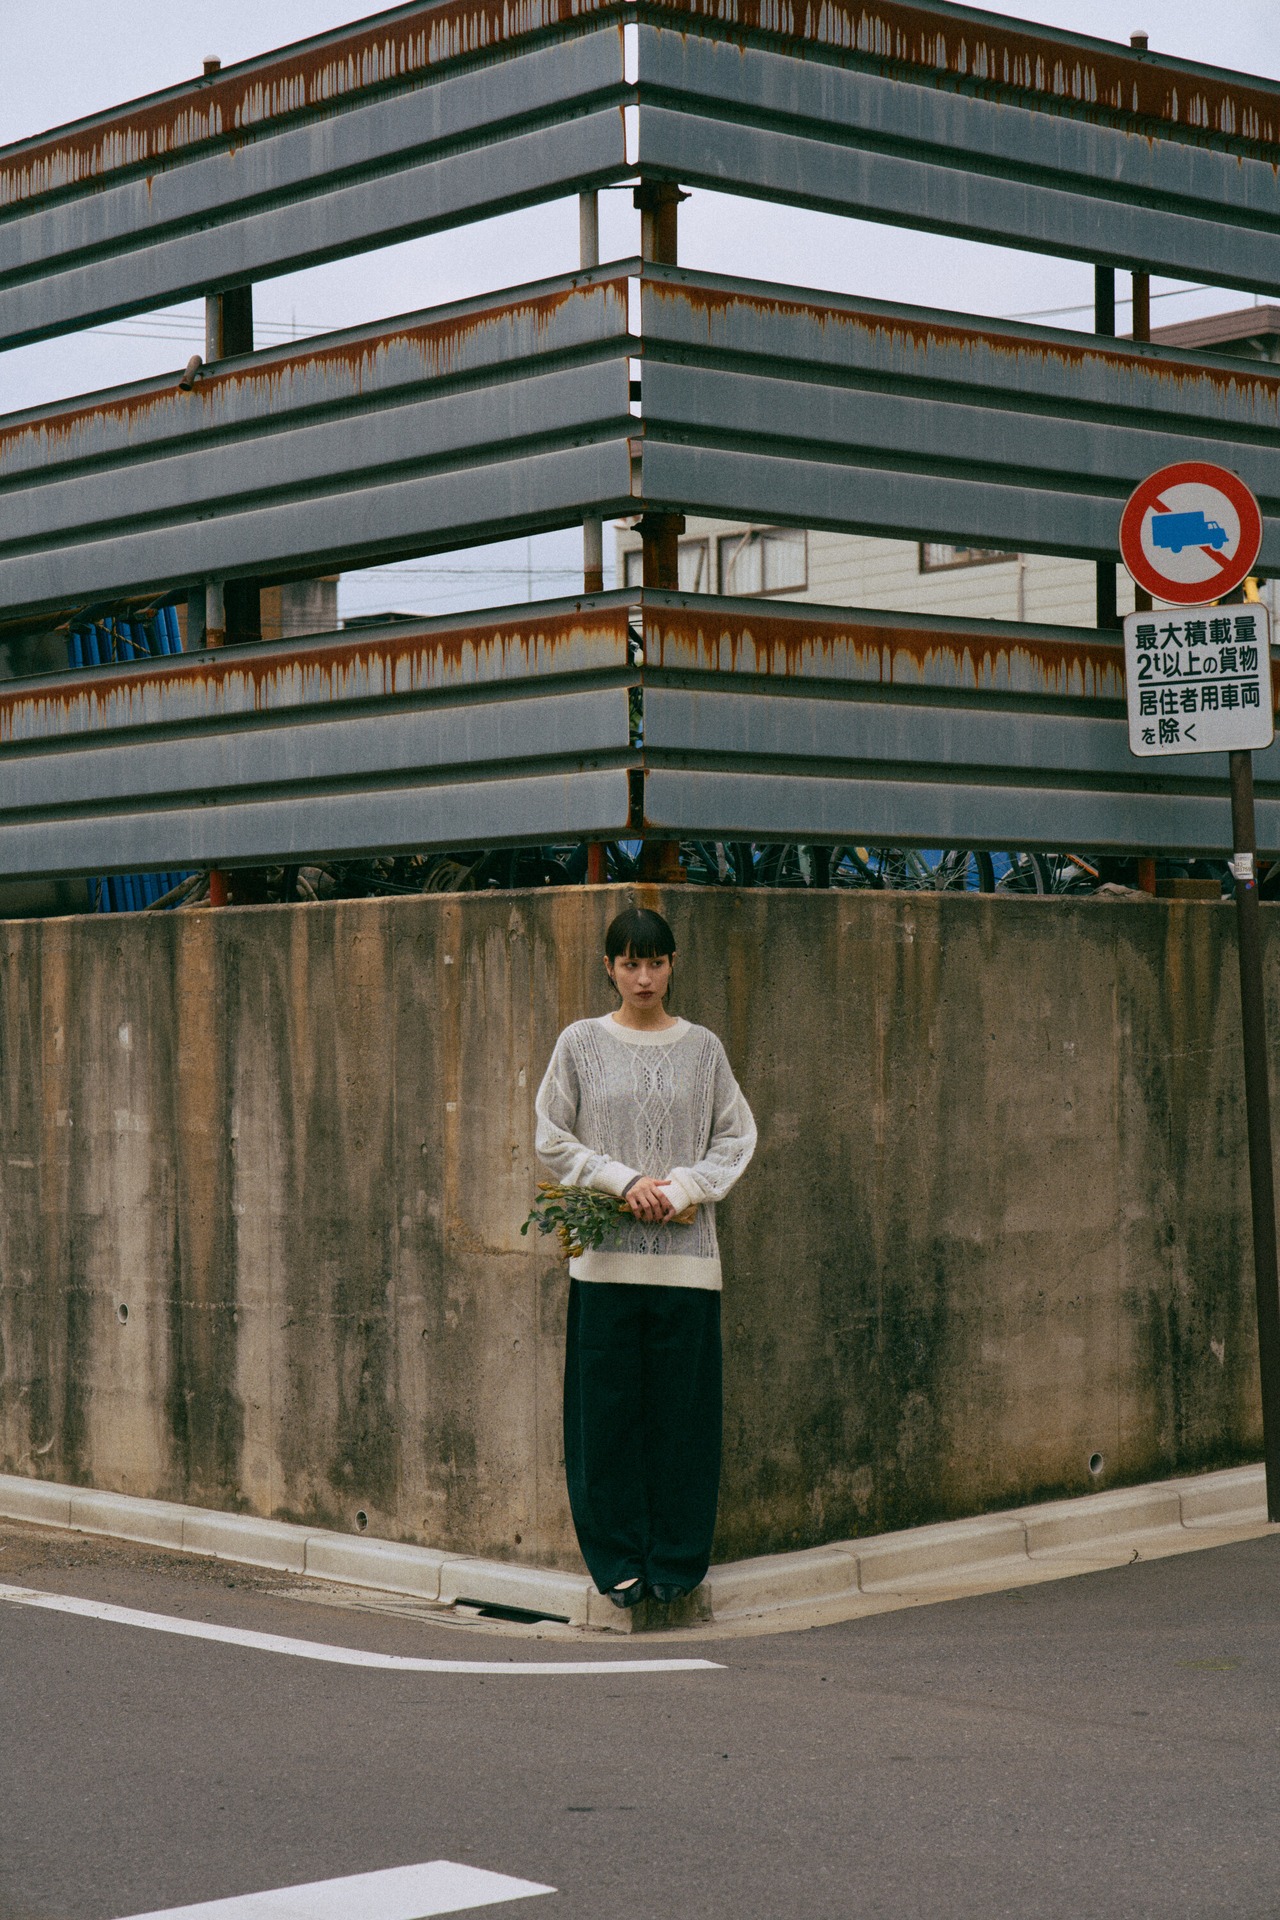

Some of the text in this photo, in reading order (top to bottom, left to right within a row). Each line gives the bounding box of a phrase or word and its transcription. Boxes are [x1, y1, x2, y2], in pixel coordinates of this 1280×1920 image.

[1135, 616, 1257, 650] 最大積載量
[1137, 645, 1258, 680] 2t以上の貨物
[1139, 682, 1260, 716] 居住者用車両
[1142, 718, 1197, 745] を除く
